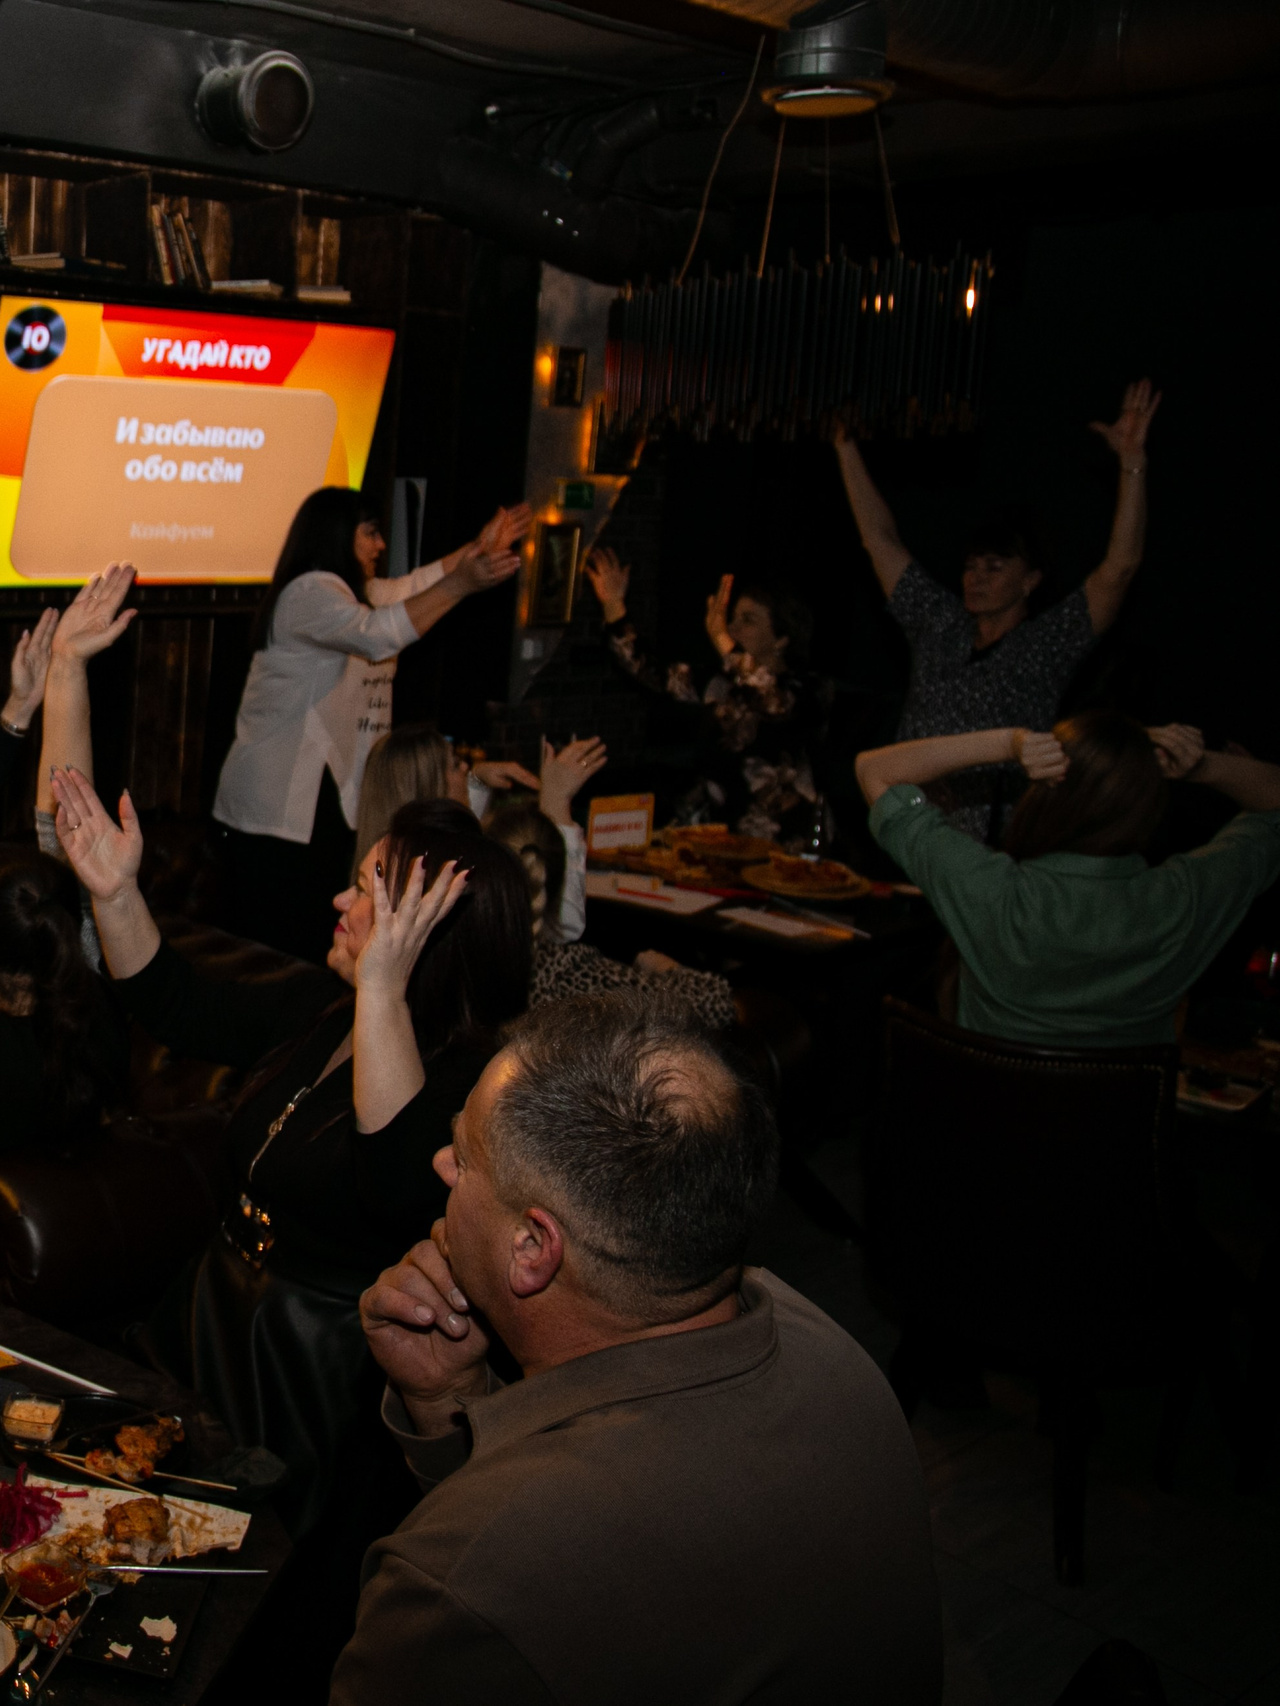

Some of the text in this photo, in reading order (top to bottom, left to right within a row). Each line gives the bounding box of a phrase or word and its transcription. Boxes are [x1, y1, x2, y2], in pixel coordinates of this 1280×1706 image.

[141, 337, 271, 371] УГАДАЙ КТО
[114, 416, 266, 449] И забываю
[124, 454, 244, 483] обо всём
